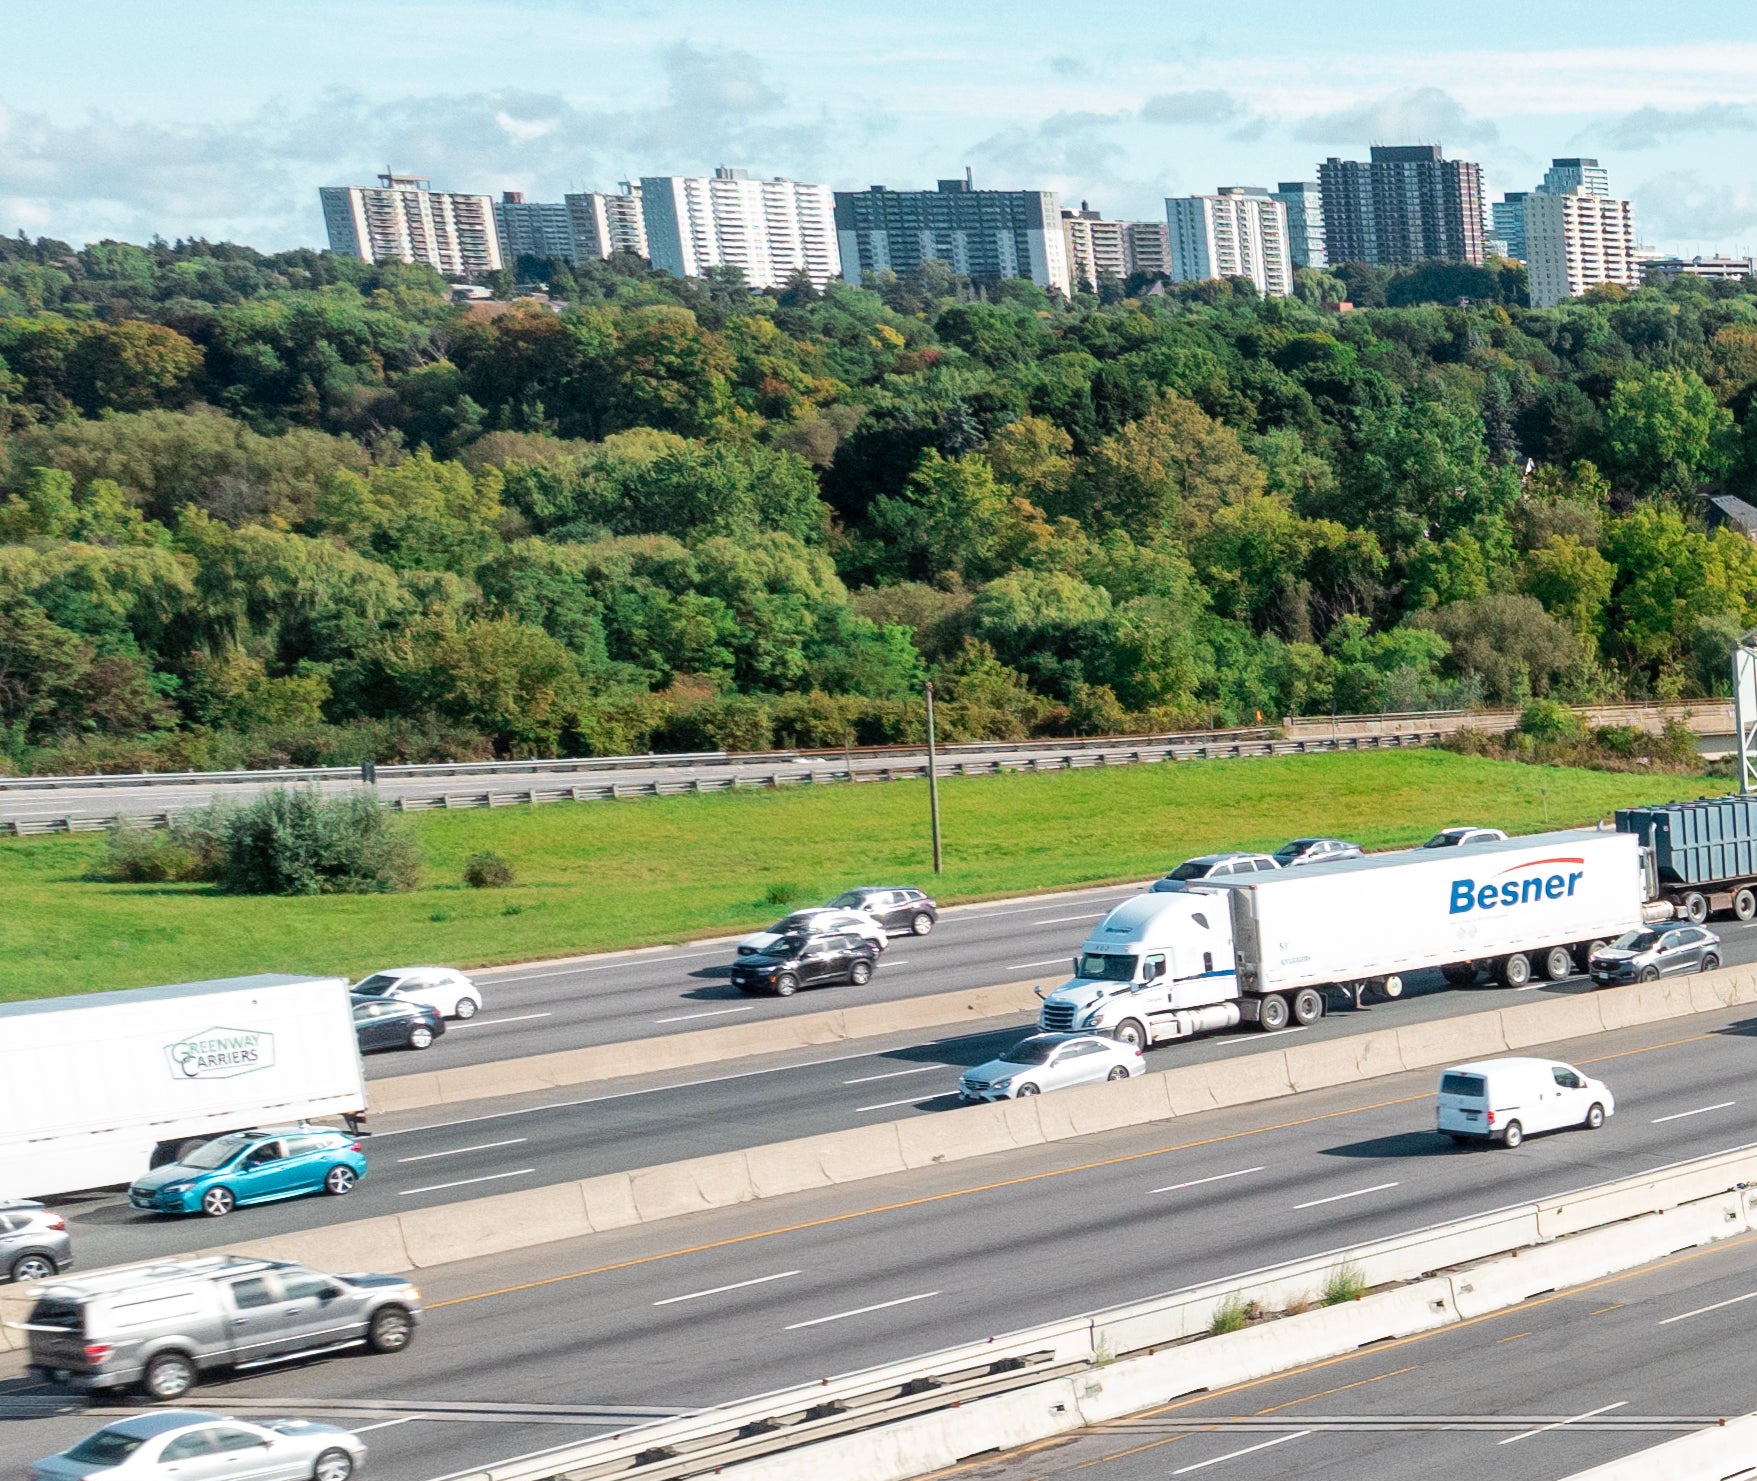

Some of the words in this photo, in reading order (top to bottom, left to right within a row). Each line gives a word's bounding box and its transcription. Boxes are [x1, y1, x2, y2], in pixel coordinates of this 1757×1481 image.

[1449, 871, 1584, 915] Besner
[171, 1034, 260, 1064] GREENWAY
[181, 1049, 259, 1077] CARRIERS
